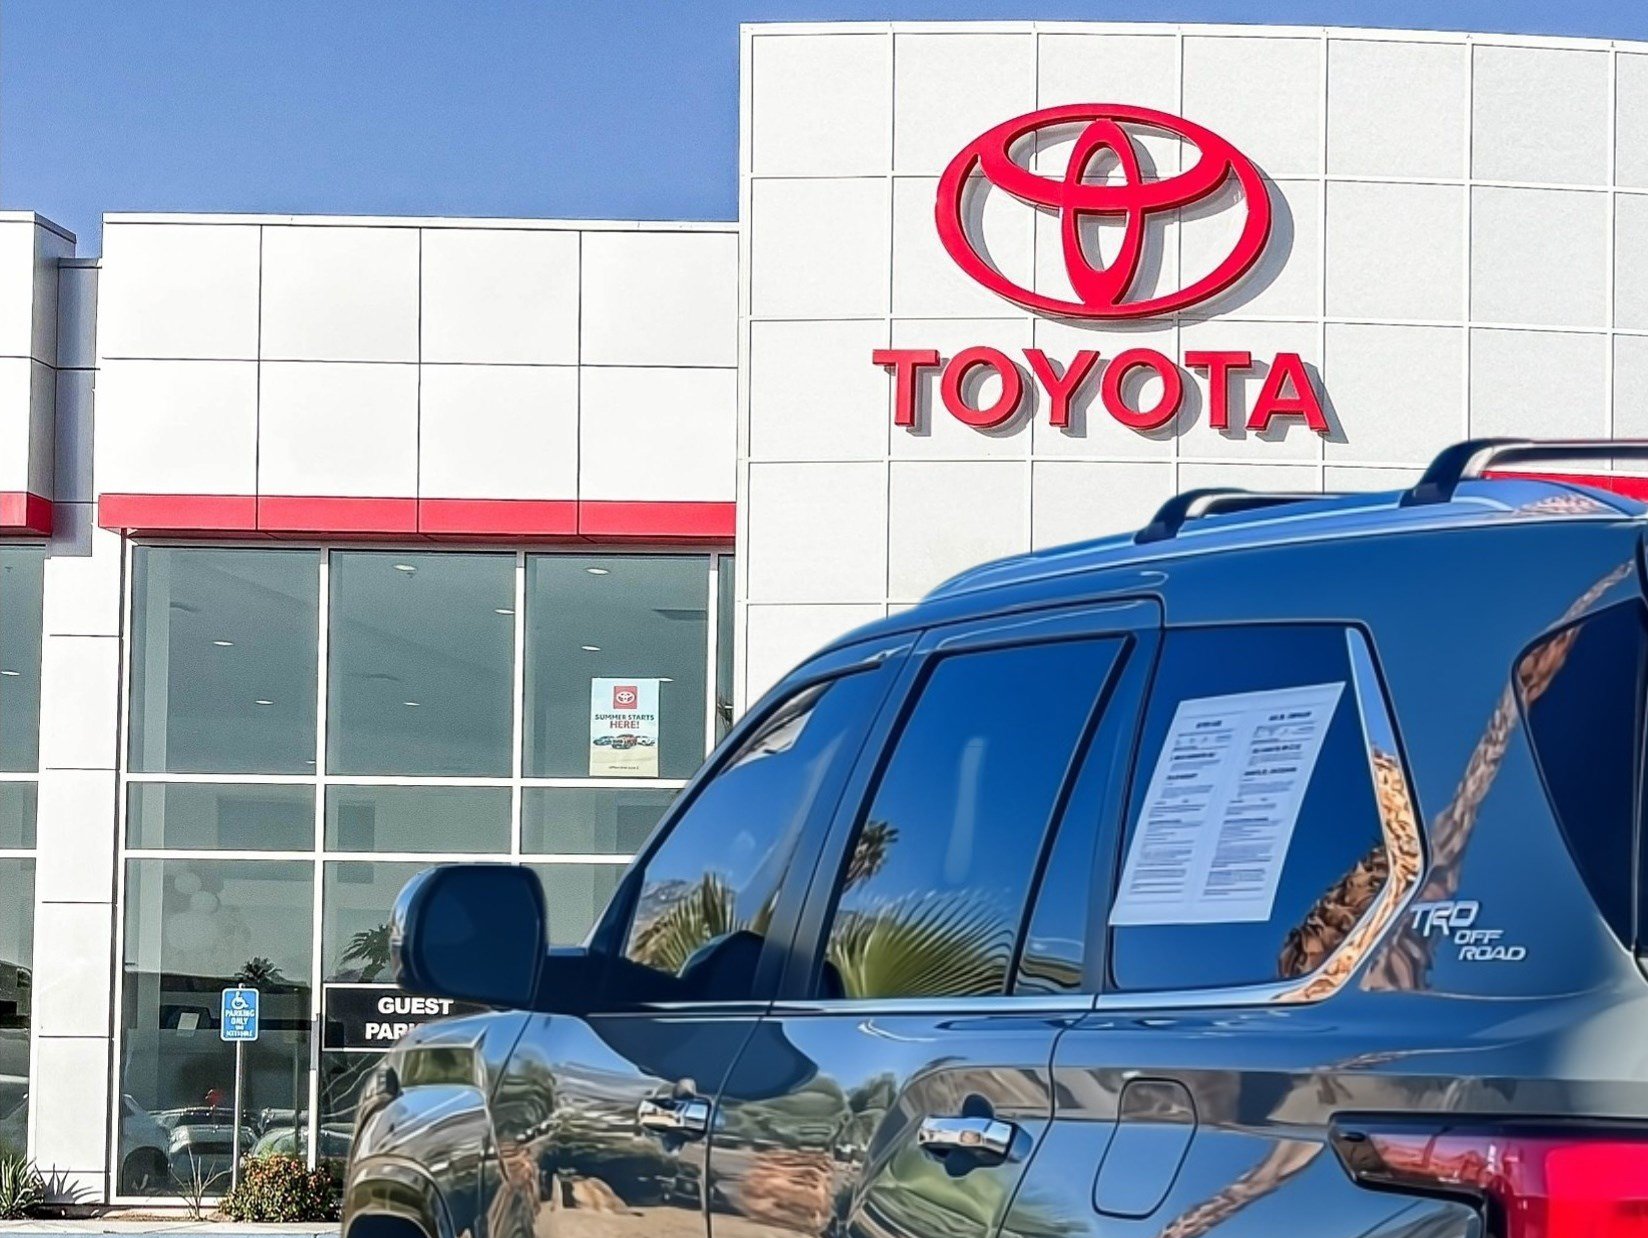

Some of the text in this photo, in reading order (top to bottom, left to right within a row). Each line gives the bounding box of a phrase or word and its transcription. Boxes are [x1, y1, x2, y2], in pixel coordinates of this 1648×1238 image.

[872, 346, 1330, 432] TOYOTA
[609, 720, 640, 729] HERE!
[1410, 900, 1479, 937] TRD
[1453, 929, 1504, 945] OFF
[1458, 945, 1526, 961] ROAD
[377, 997, 454, 1014] GUEST
